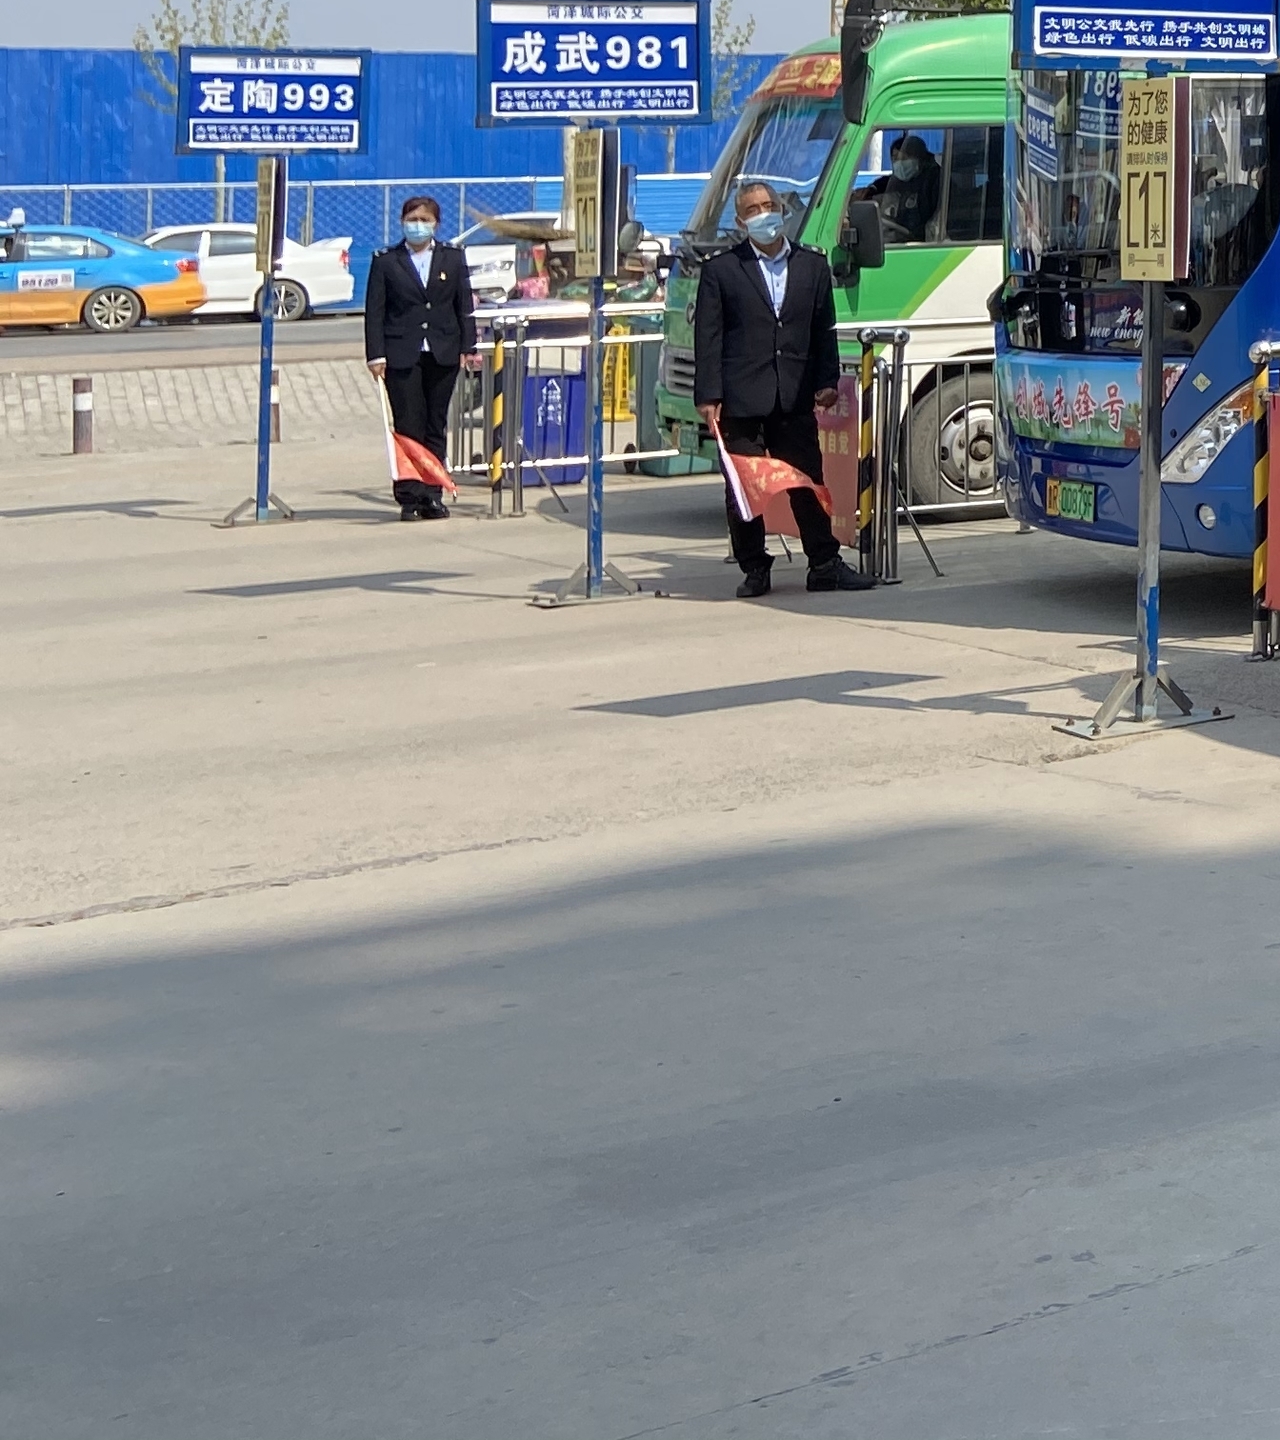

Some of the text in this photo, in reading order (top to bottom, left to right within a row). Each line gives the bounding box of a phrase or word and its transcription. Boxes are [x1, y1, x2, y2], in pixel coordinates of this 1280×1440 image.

[501, 30, 688, 74] 成武981
[1199, 36, 1267, 50] 文明出行
[198, 77, 354, 113] 定陶993
[1127, 89, 1168, 117] 为了您
[1126, 119, 1168, 146] 的健康
[1115, 305, 1143, 326] 新能
[1114, 325, 1144, 348] energ
